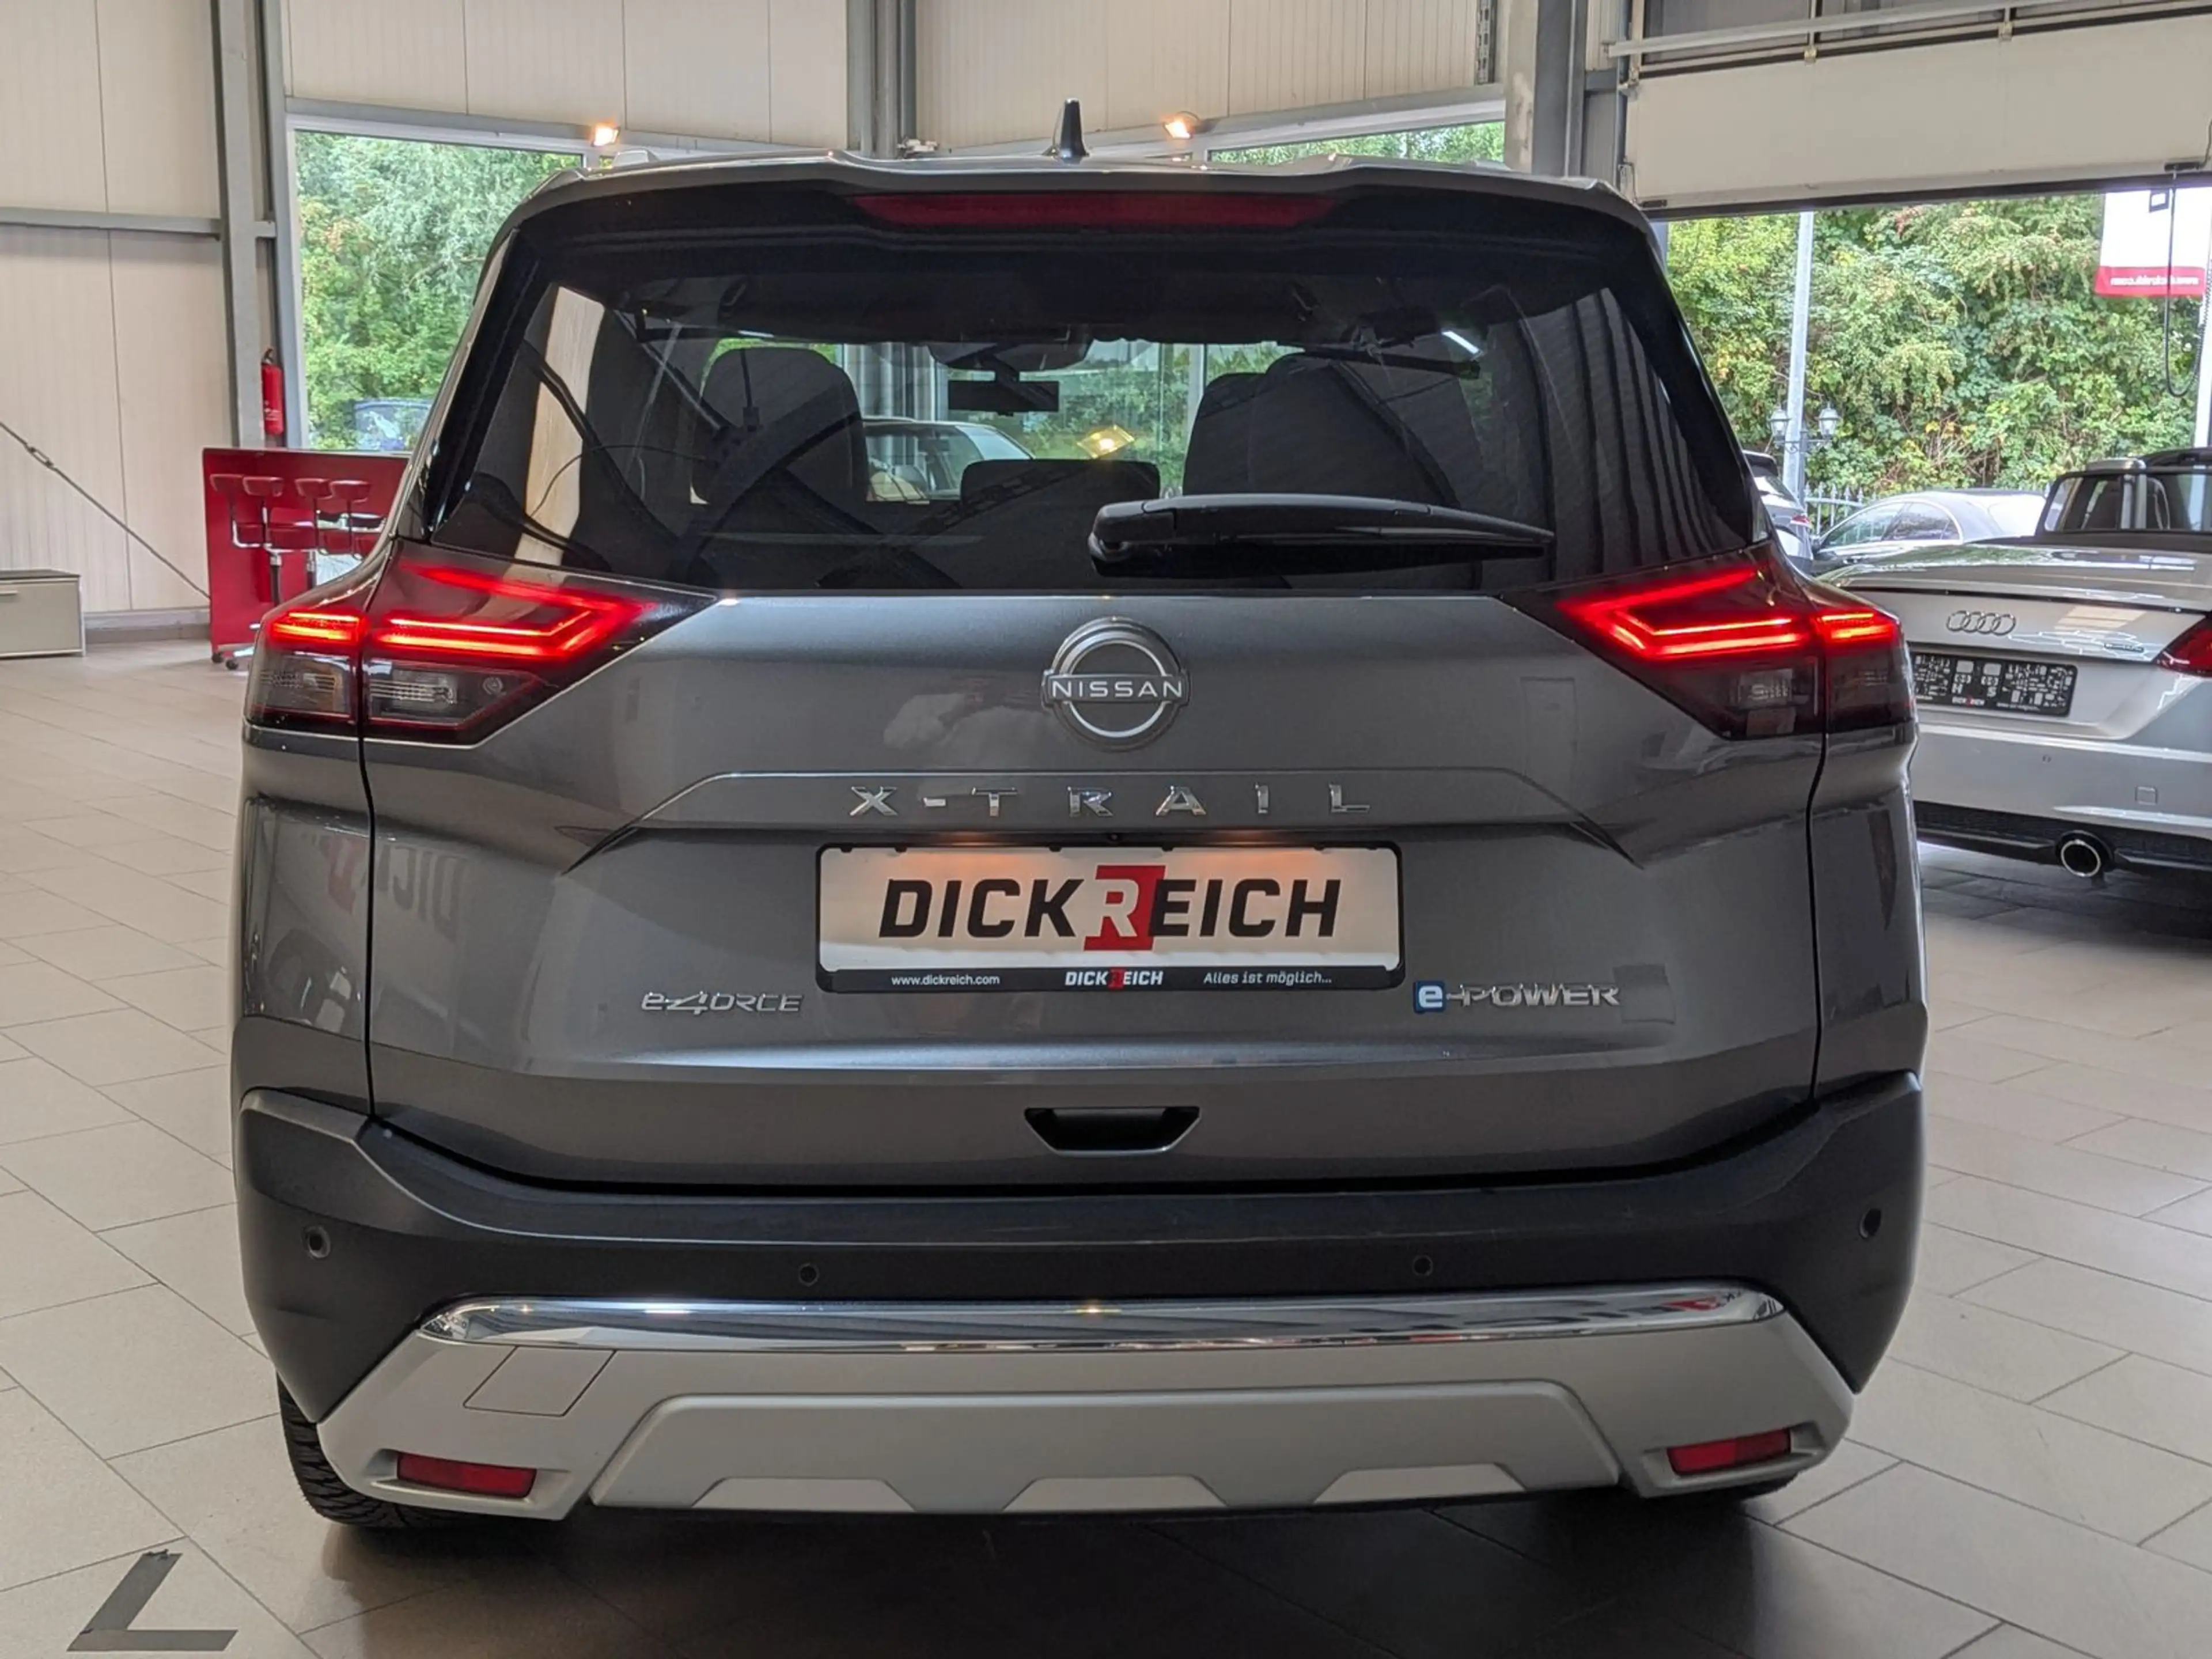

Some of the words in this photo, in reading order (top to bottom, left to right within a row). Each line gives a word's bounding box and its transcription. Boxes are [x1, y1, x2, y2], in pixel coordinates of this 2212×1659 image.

[1051, 680, 1182, 698] NISSAN
[850, 785, 1371, 817] X-TRAIL
[879, 877, 1341, 939] DICKREICH
[891, 974, 1001, 986] www.dickreich.com
[1203, 972, 1240, 984] Alles
[1241, 971, 1263, 984] ist
[1418, 983, 1620, 1008] e-POWER
